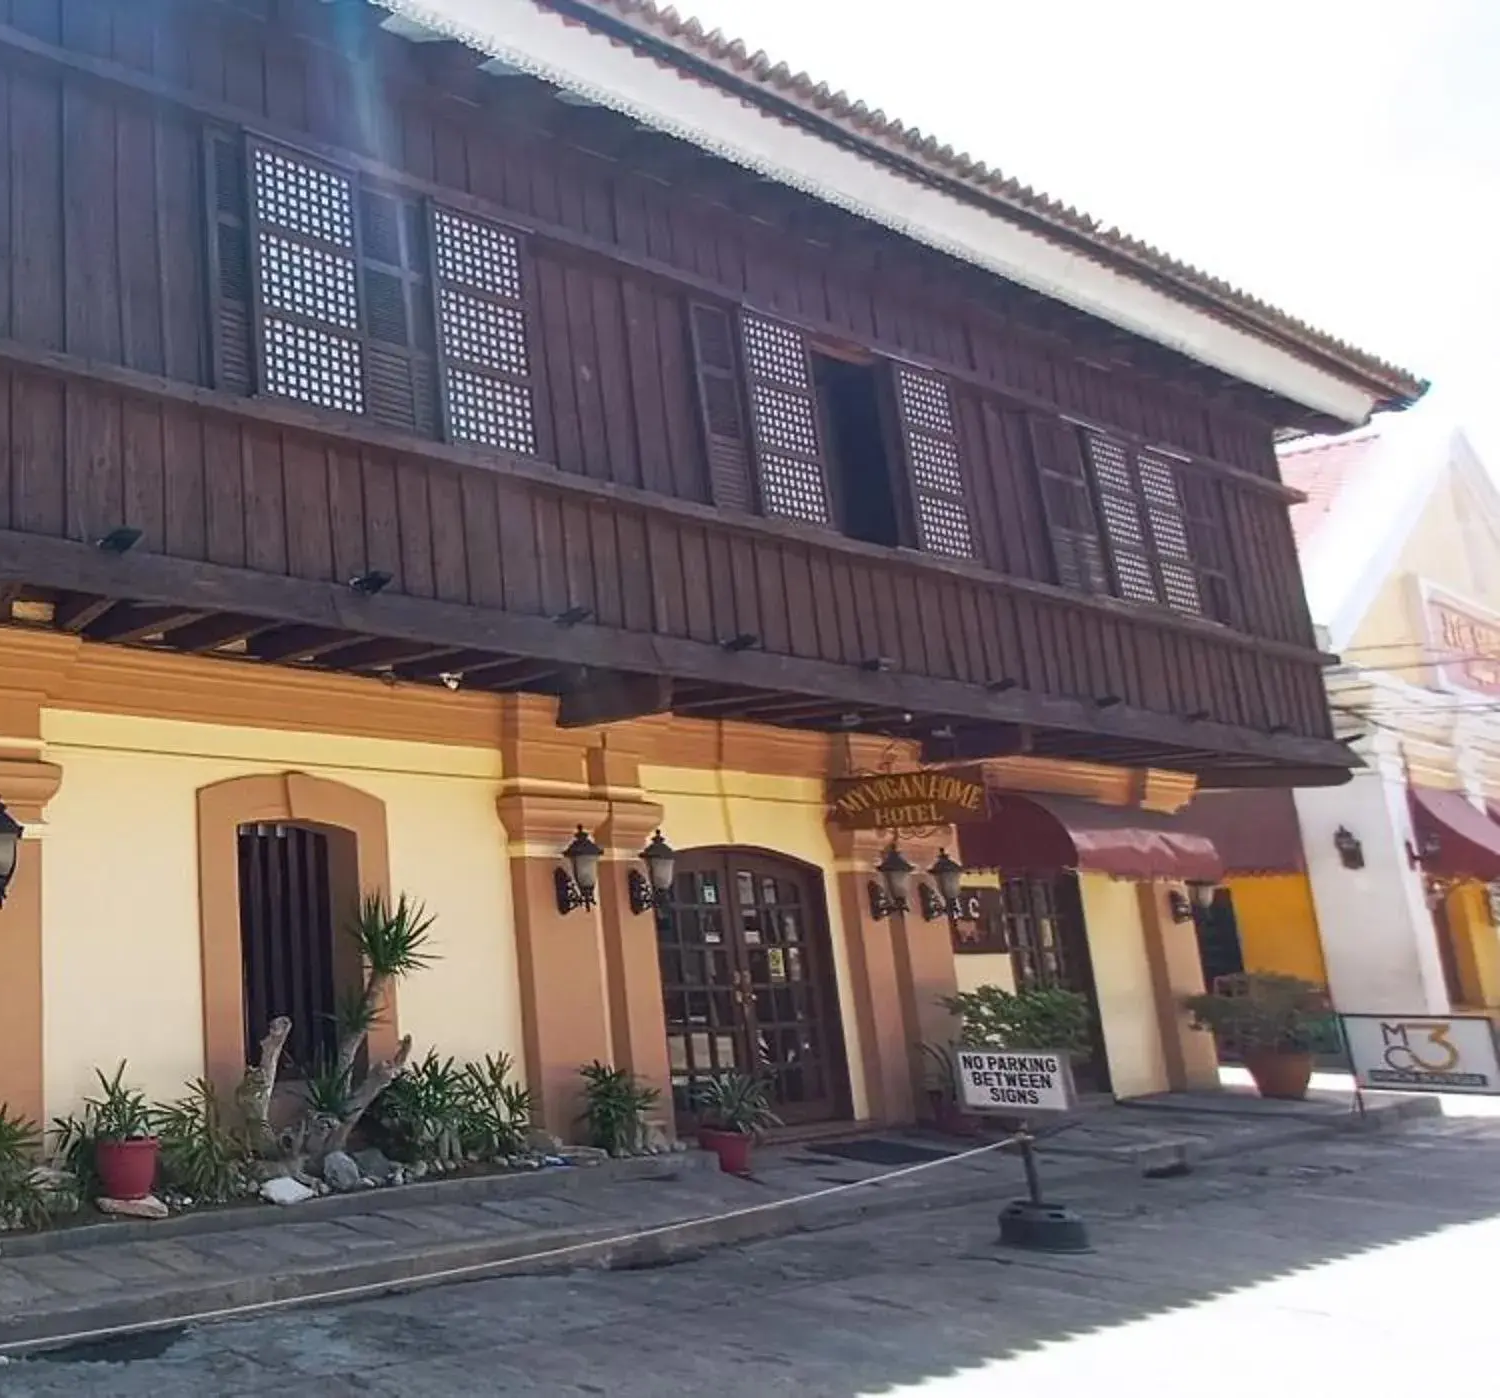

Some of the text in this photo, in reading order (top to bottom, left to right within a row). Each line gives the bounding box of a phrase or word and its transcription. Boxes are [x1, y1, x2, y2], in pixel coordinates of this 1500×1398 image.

[837, 774, 982, 816] MY VIGAN HOME
[873, 804, 943, 825] HOTEL
[962, 1055, 1057, 1073] NO PARKING
[971, 1071, 1053, 1088] BETWEEN
[989, 1087, 1040, 1104] SIGNS
